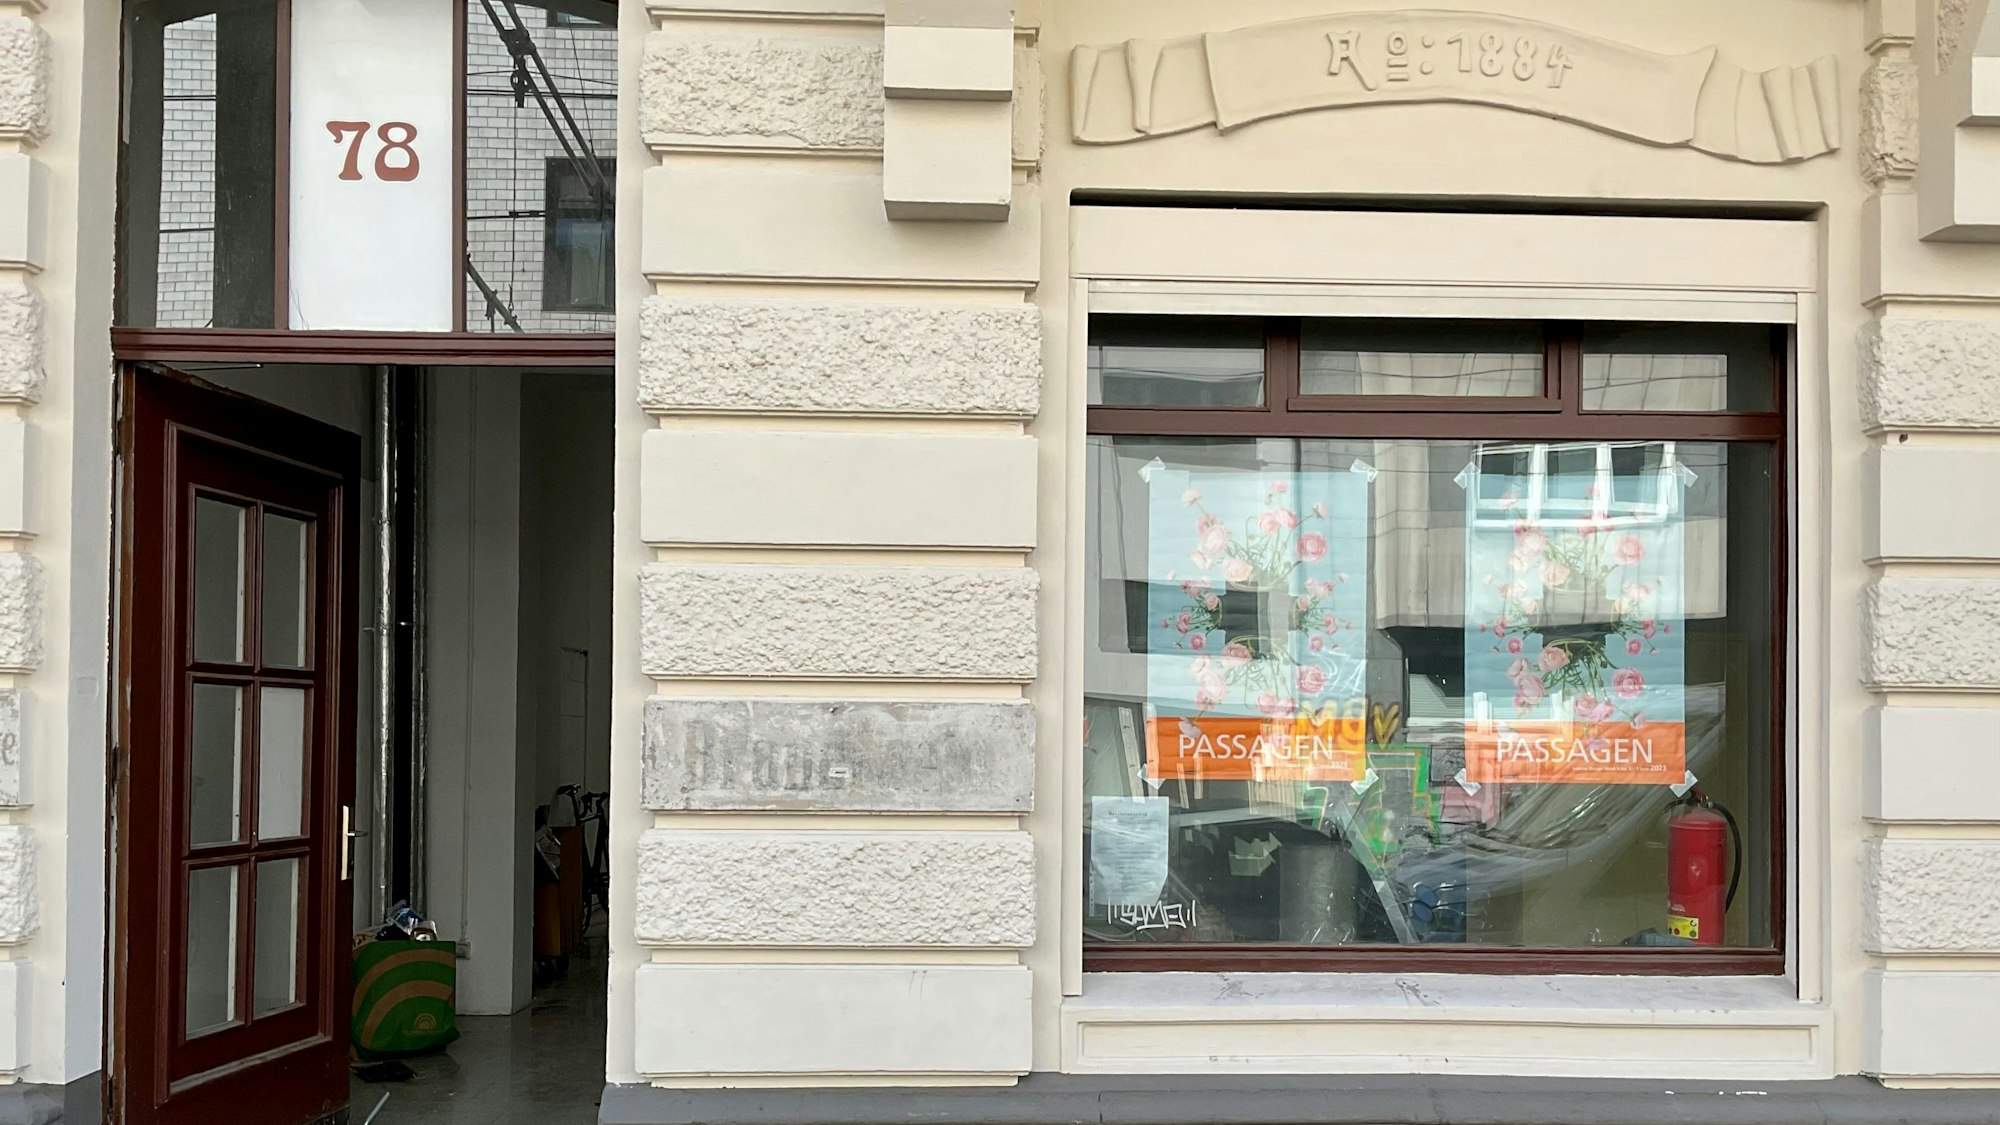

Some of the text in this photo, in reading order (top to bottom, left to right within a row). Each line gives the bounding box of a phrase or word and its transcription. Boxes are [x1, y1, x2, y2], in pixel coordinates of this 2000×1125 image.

[1446, 31, 1573, 89] 1884
[325, 120, 421, 182] 78
[1178, 733, 1333, 760] PASSAGEN
[1496, 737, 1653, 763] PASSAGEN
[1650, 764, 1667, 772] 2023
